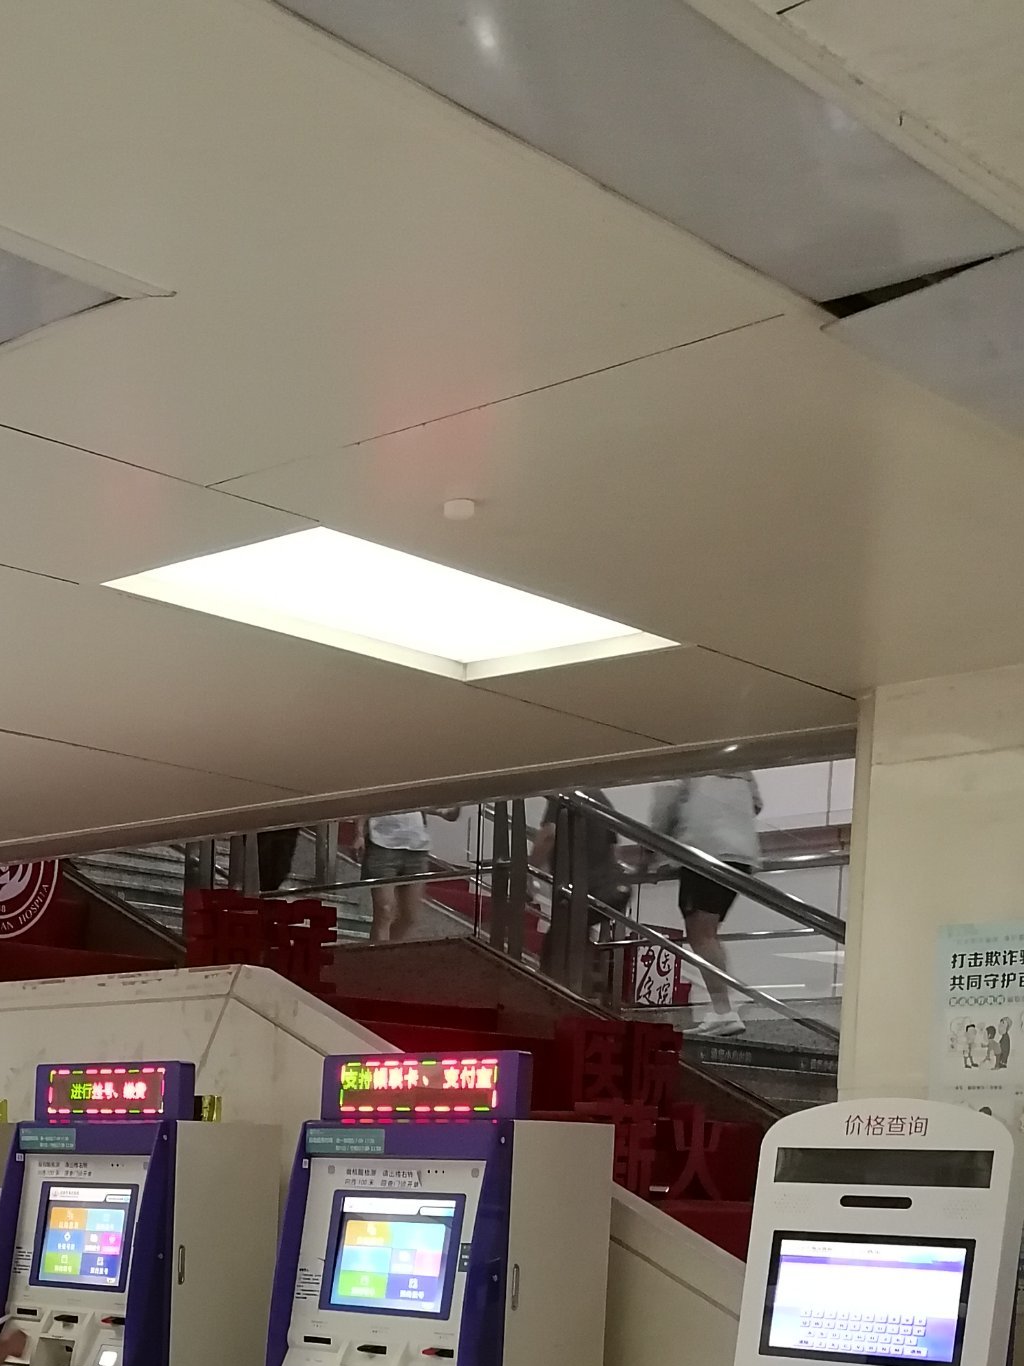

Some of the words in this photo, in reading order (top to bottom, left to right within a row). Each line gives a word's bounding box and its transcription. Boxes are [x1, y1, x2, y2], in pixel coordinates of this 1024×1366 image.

[951, 950, 1024, 969] 打击欺诈
[845, 1114, 929, 1136] 价格查询
